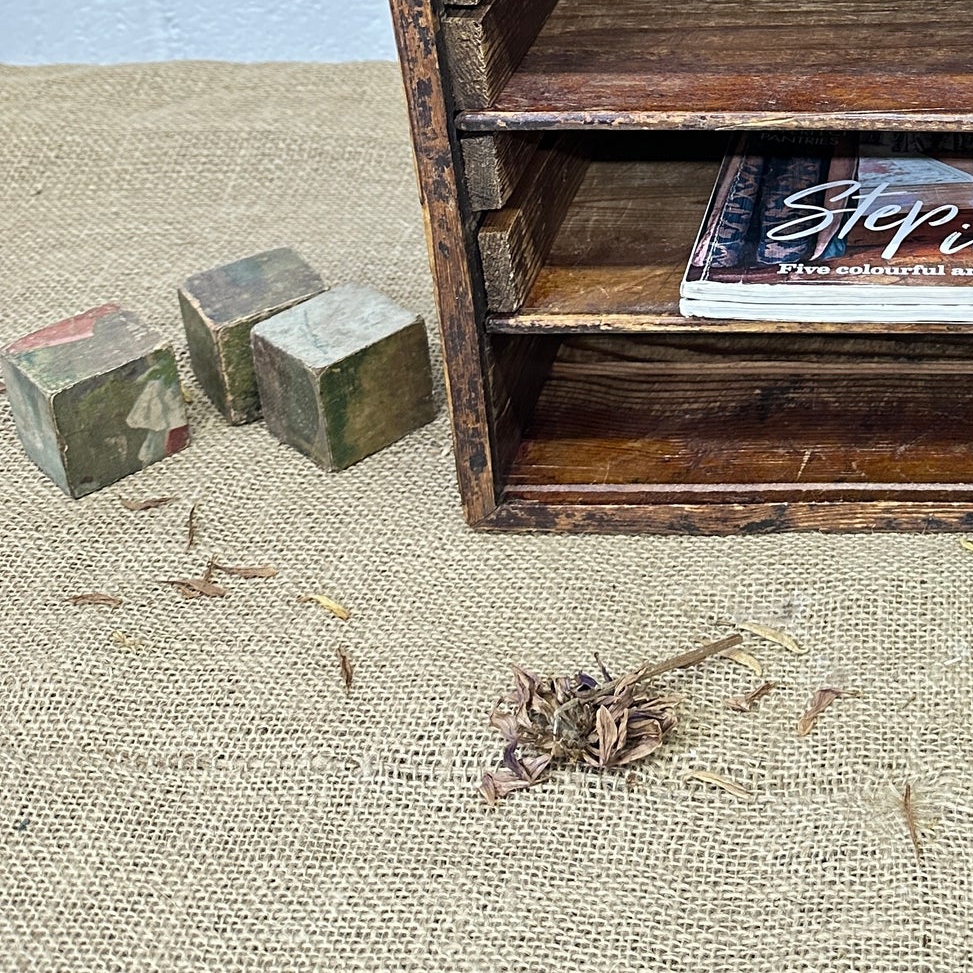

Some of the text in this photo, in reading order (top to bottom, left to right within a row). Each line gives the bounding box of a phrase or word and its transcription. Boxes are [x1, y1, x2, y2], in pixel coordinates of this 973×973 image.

[766, 179, 958, 260] Step
[776, 263, 831, 276] Five
[836, 263, 945, 277] colourful
